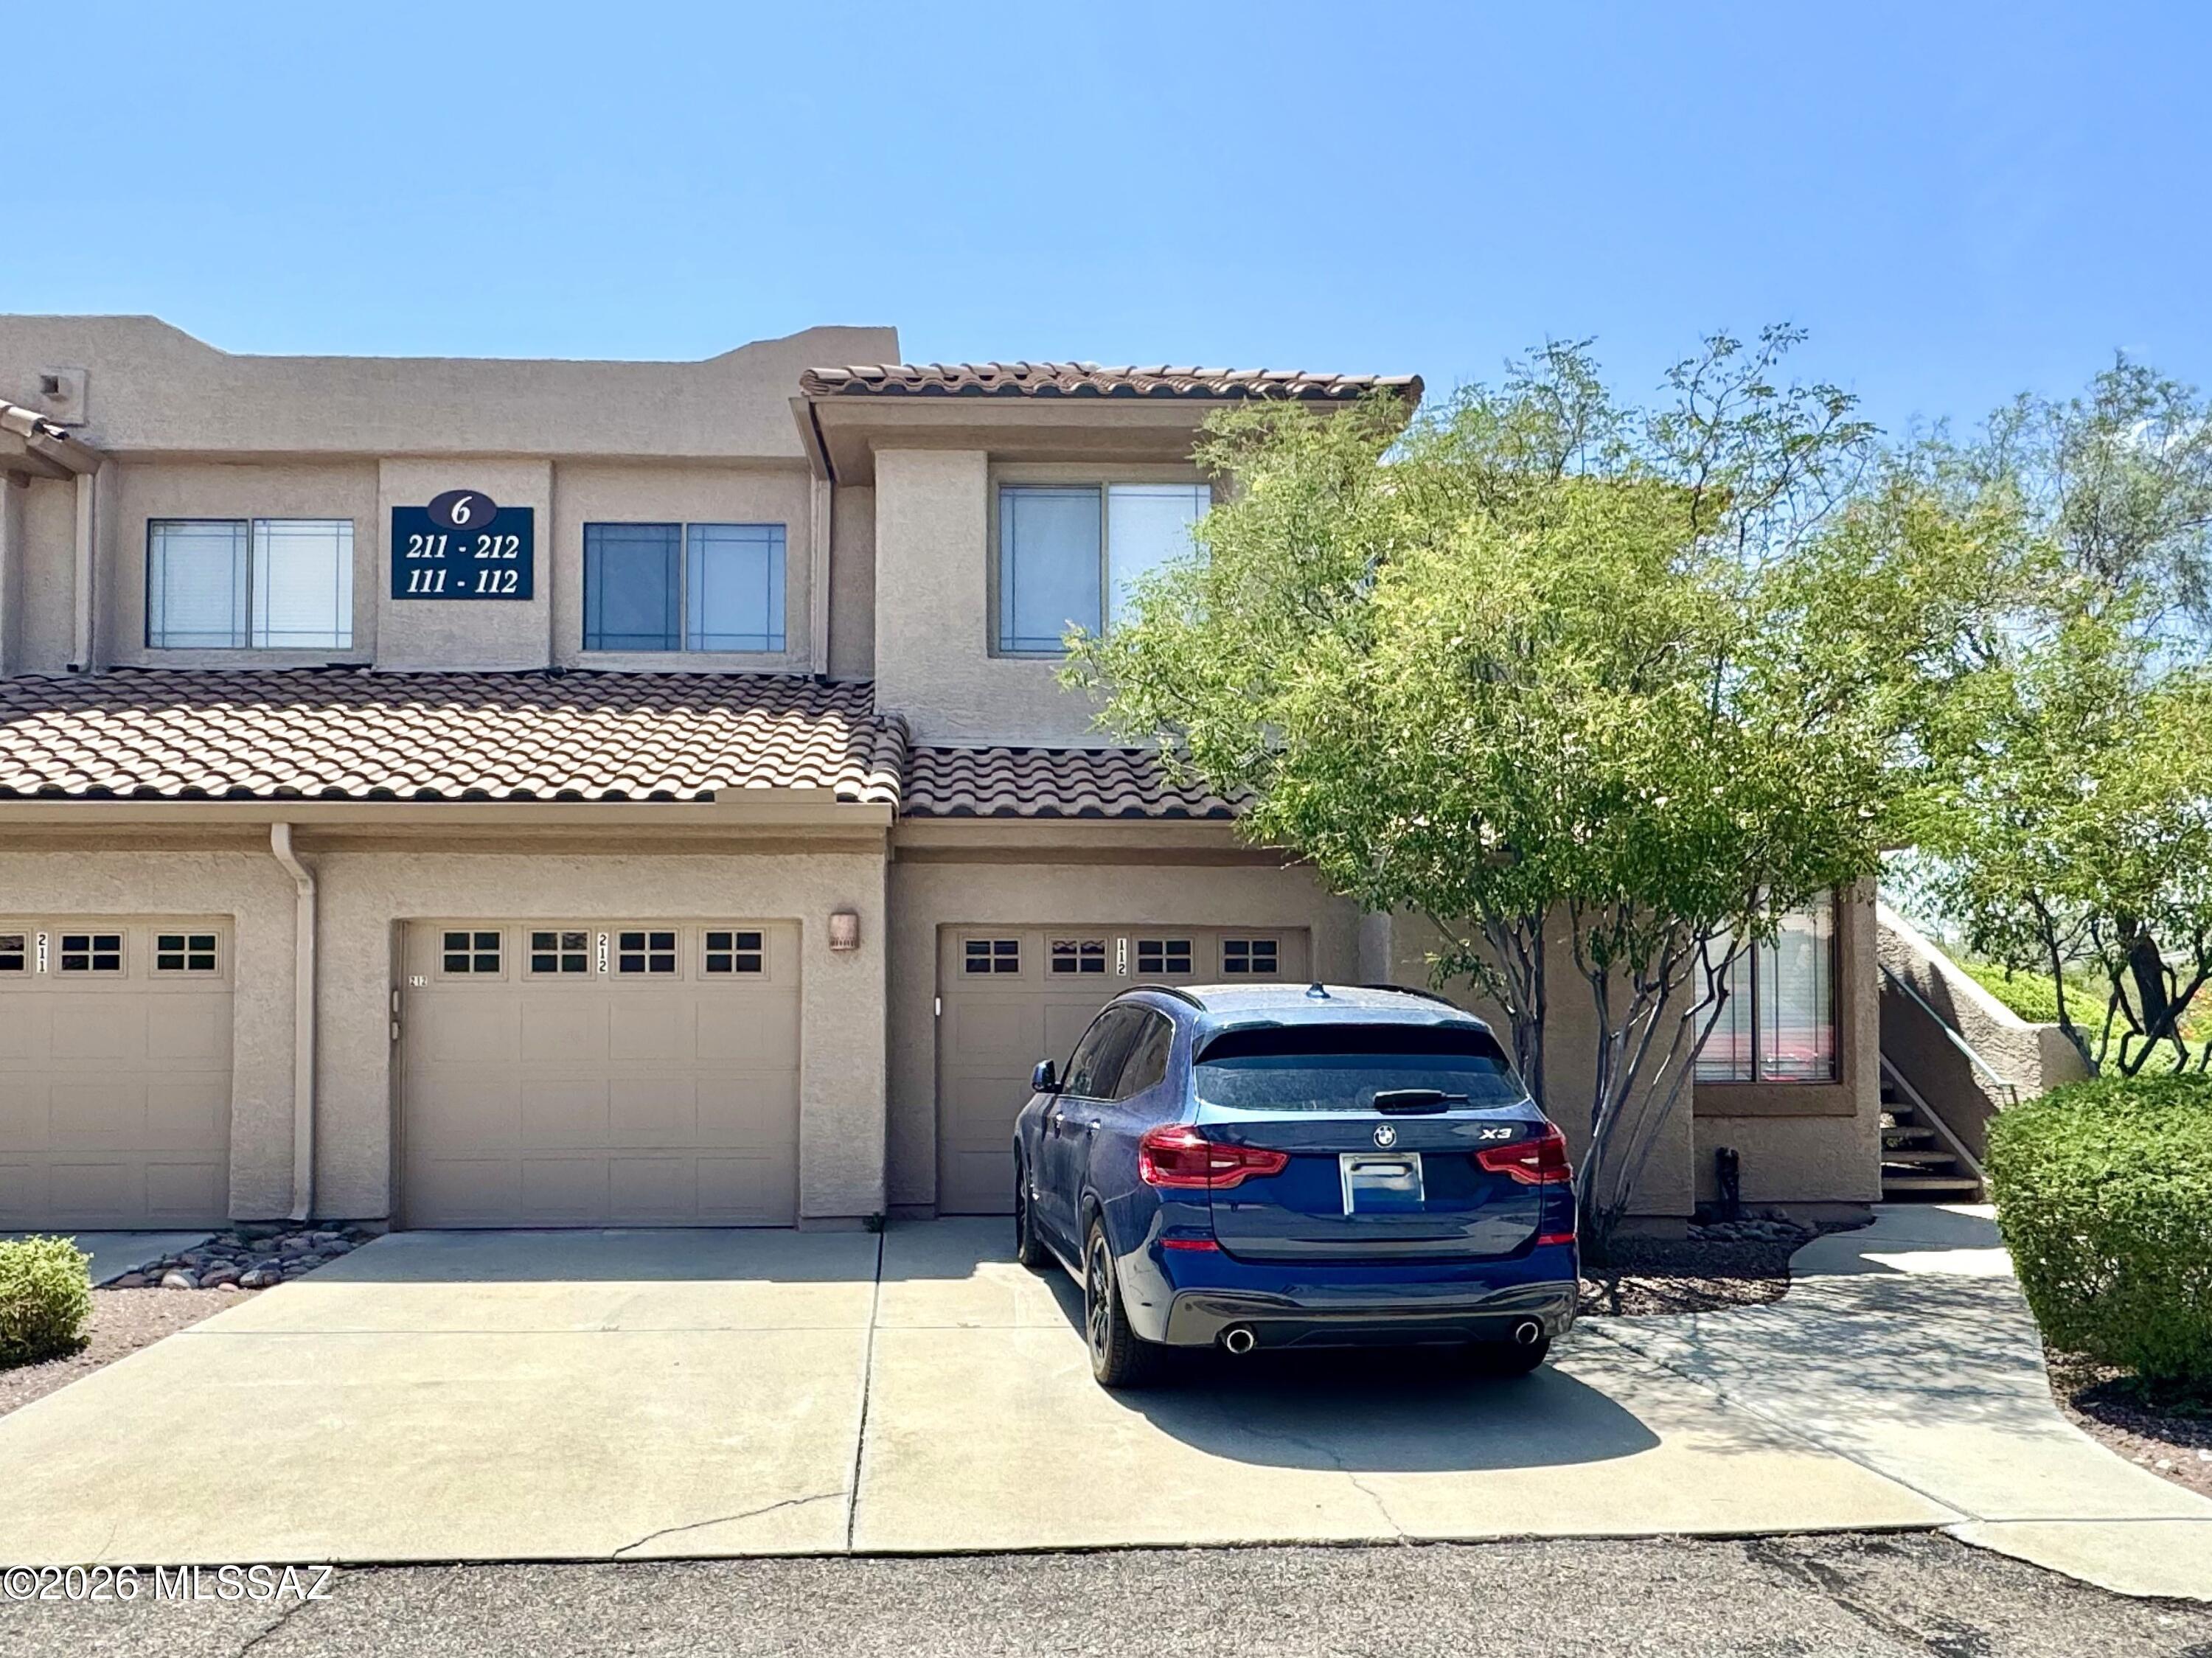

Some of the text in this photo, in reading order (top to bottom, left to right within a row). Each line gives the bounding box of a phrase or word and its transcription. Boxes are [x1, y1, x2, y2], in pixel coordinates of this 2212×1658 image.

[451, 495, 473, 525] 6
[406, 534, 448, 558] 211
[473, 534, 520, 559] 212
[406, 568, 447, 593] 111
[474, 568, 518, 593] 112
[38, 933, 46, 972] 211
[599, 933, 607, 972] 212
[410, 976, 426, 986] 212
[1478, 1128, 1512, 1140] X3
